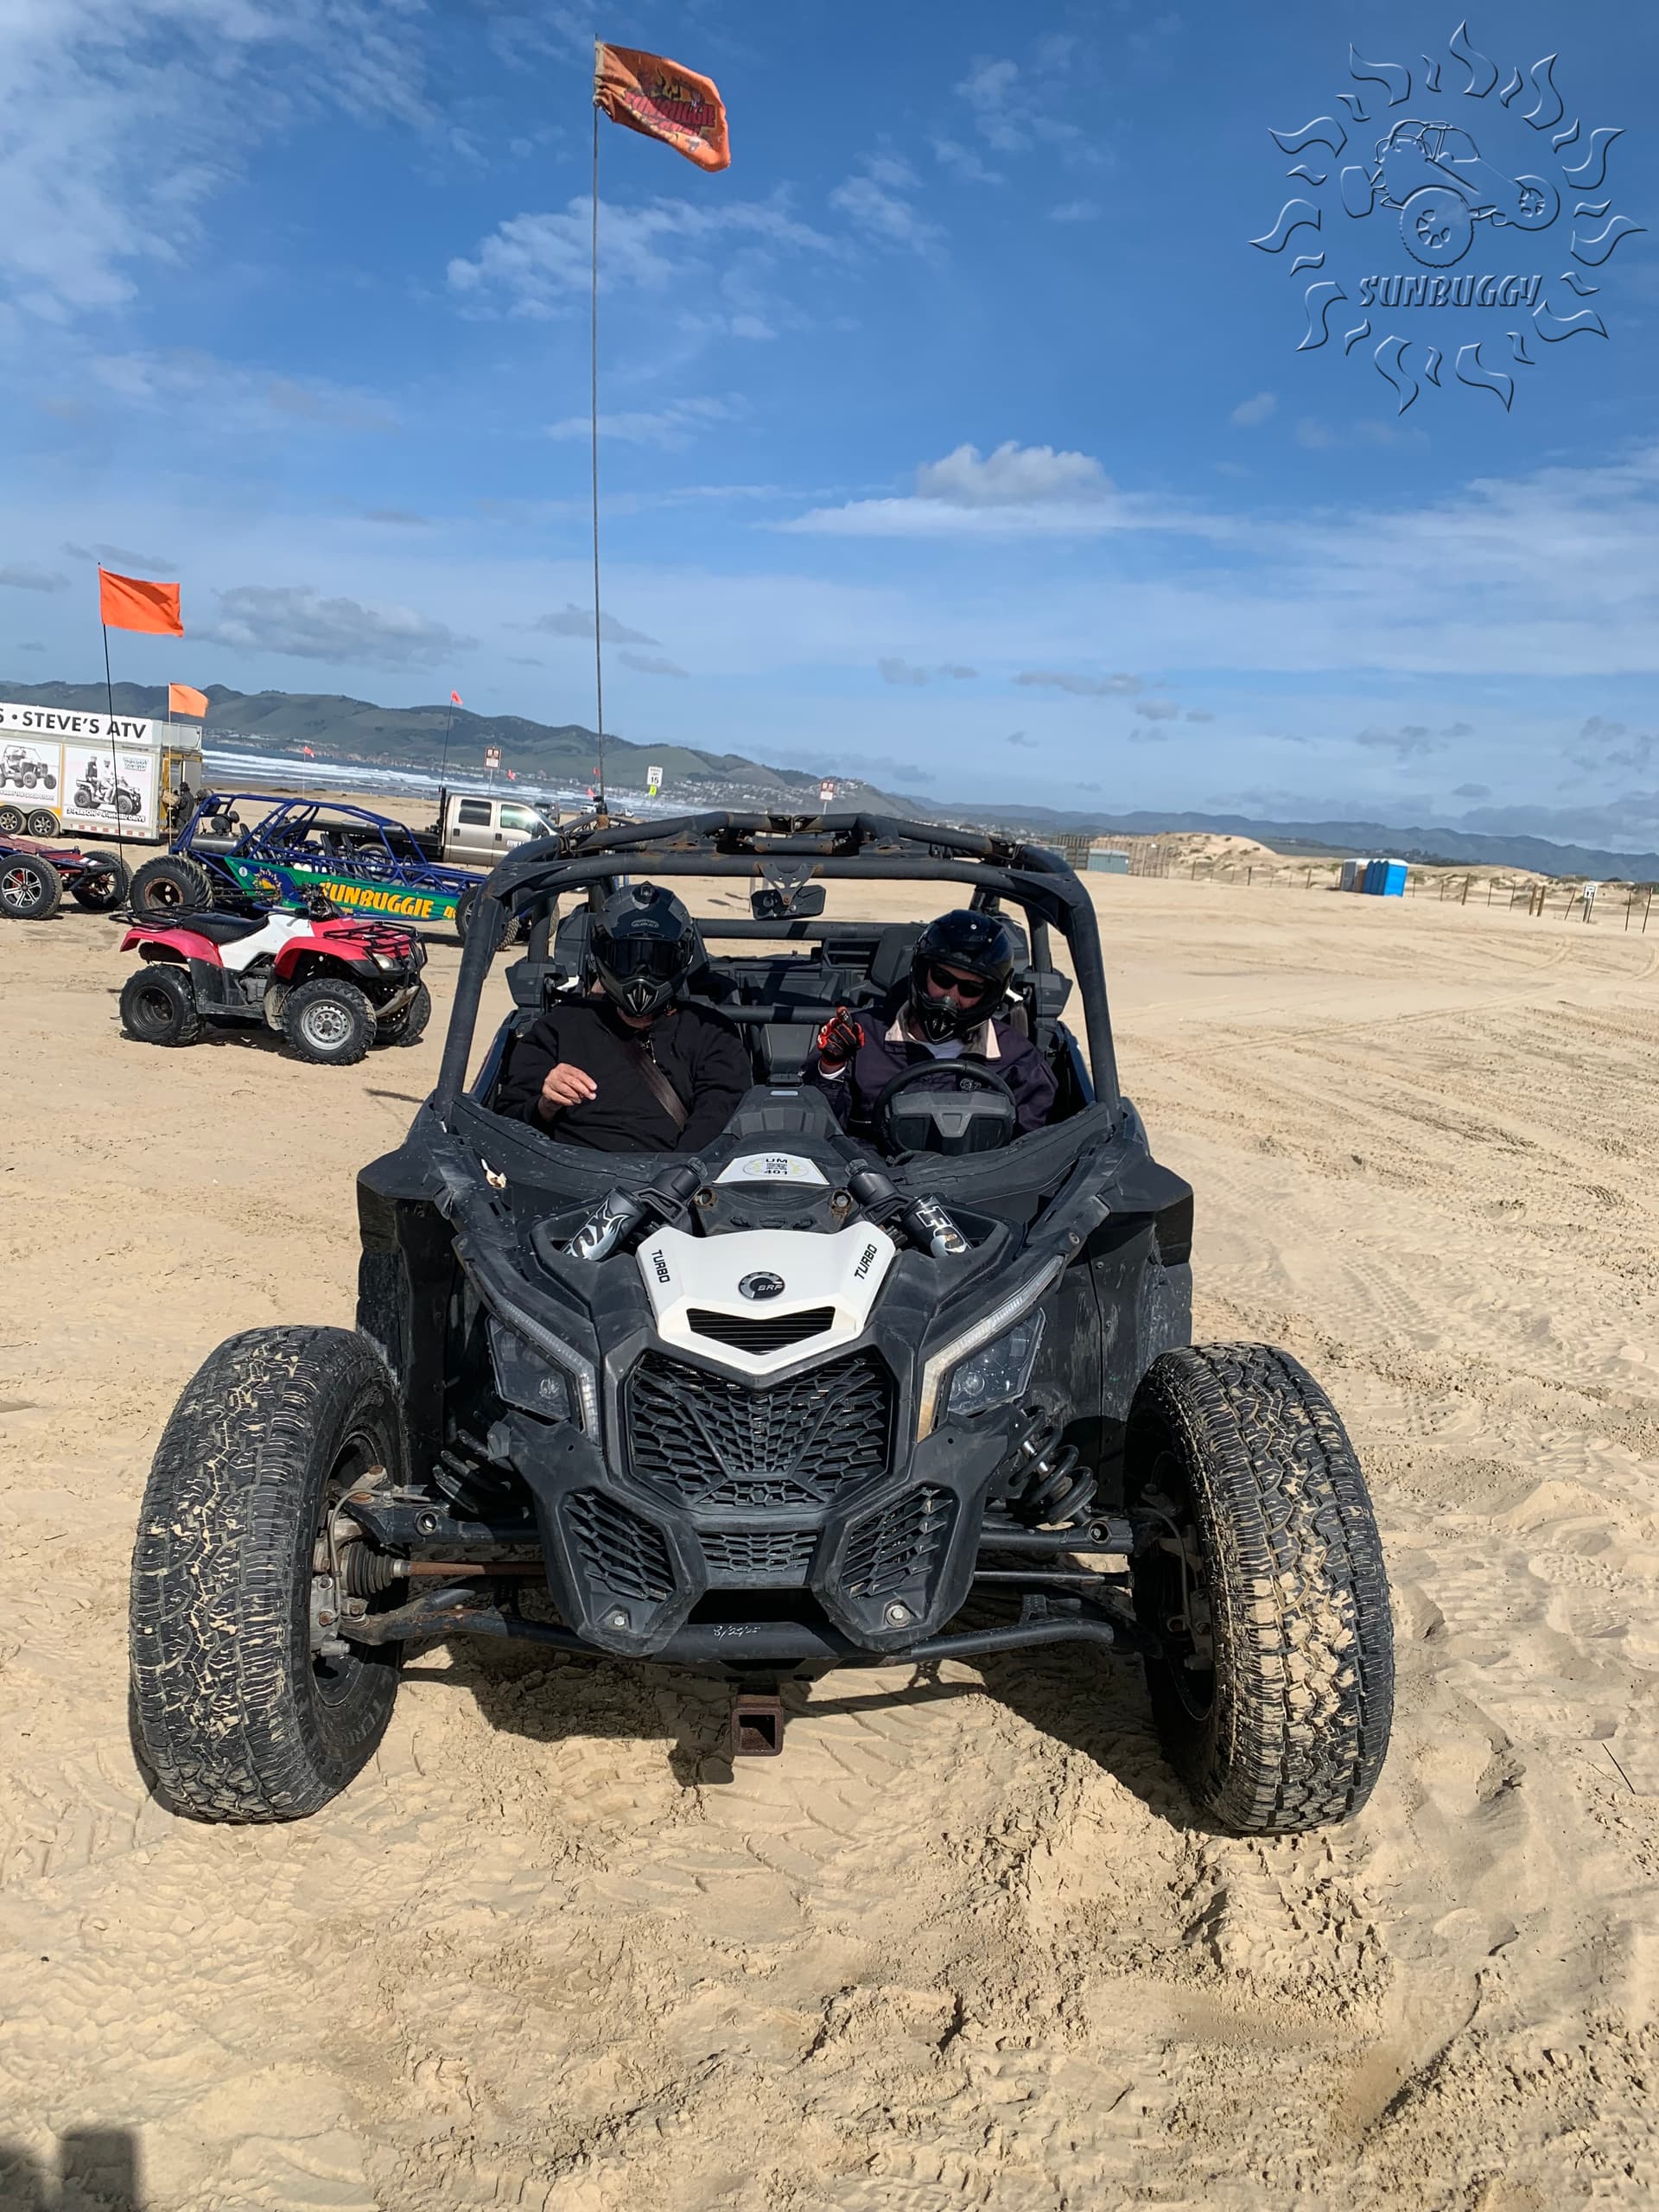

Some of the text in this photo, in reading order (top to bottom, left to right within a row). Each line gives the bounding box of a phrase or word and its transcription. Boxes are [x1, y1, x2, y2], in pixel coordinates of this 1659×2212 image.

[22, 711, 99, 734] STEVE'S
[106, 721, 146, 739] ATV
[563, 1198, 628, 1261] OX
[916, 1205, 970, 1258] FO
[652, 1249, 671, 1284] TURBO
[854, 1243, 878, 1281] TURBO
